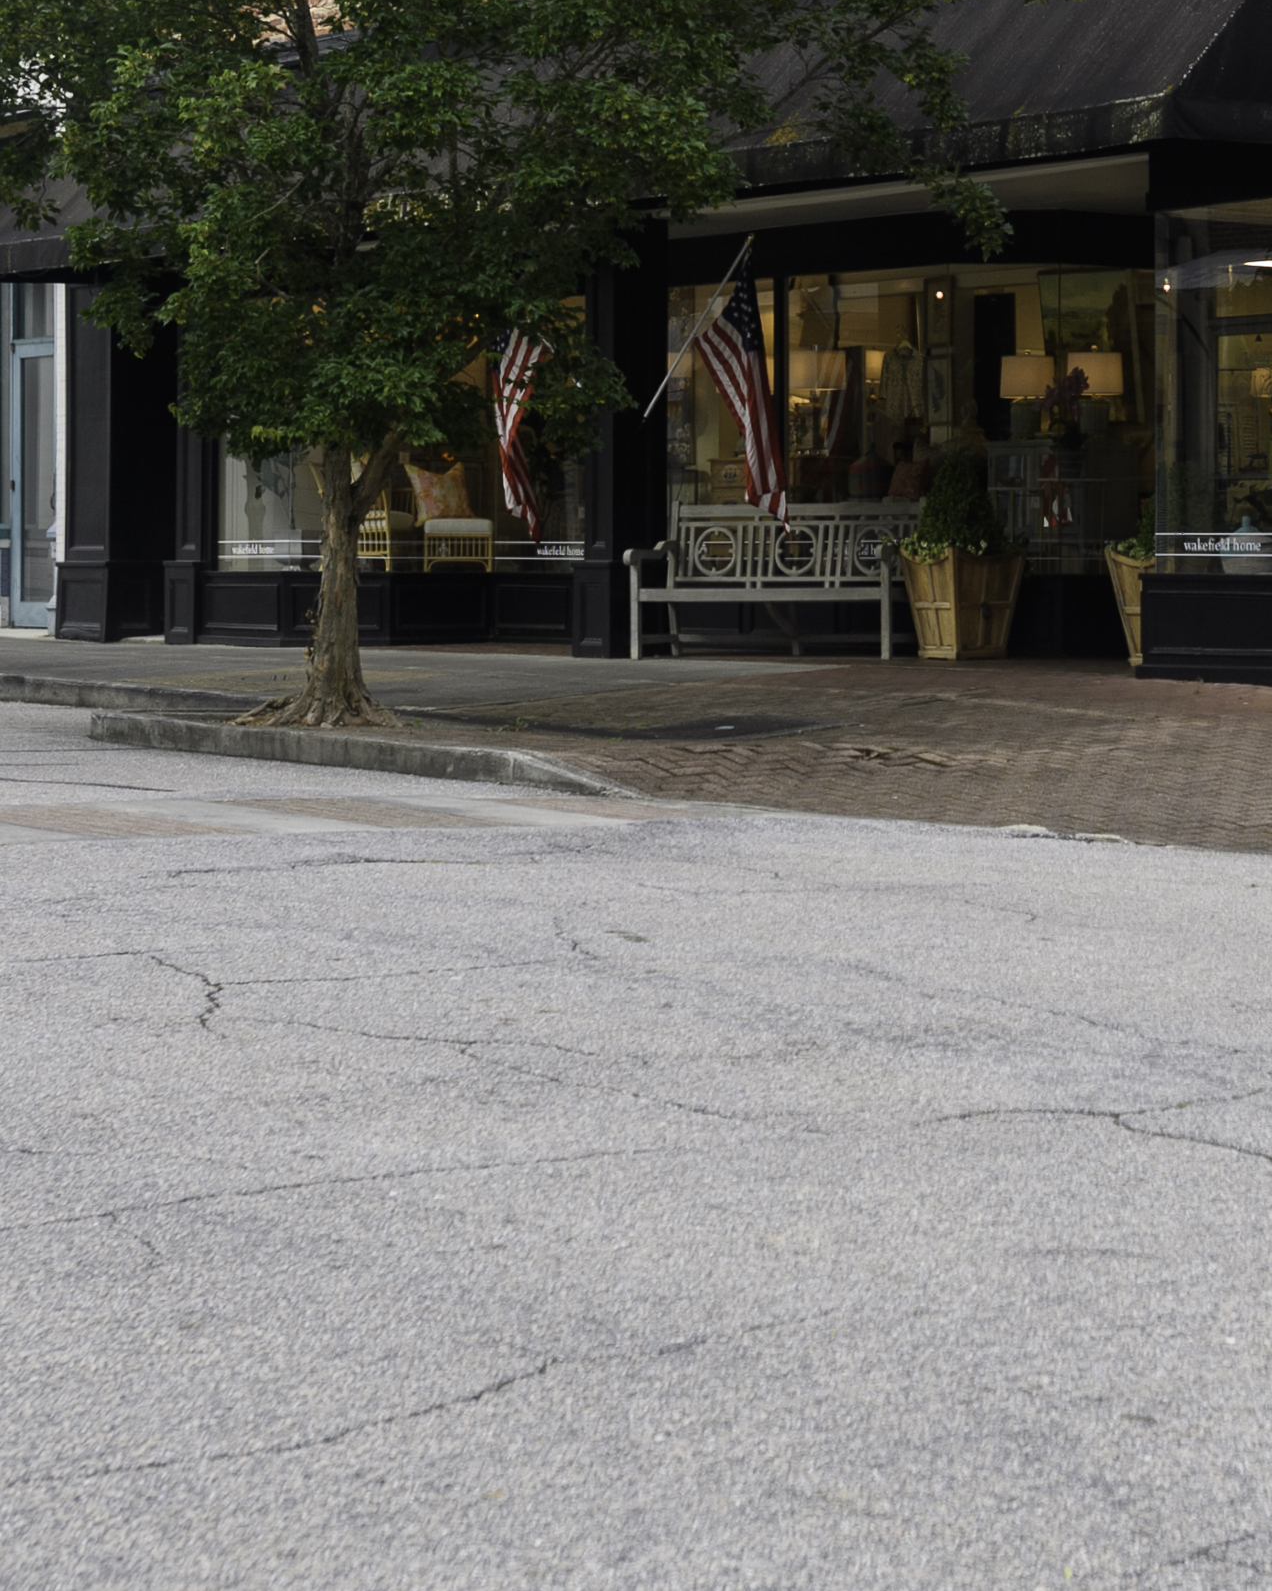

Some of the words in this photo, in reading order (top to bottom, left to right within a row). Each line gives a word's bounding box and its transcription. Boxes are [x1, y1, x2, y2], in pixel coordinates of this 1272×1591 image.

[231, 543, 258, 555] wakefield
[1183, 537, 1230, 552] wakefield
[1233, 537, 1261, 552] home
